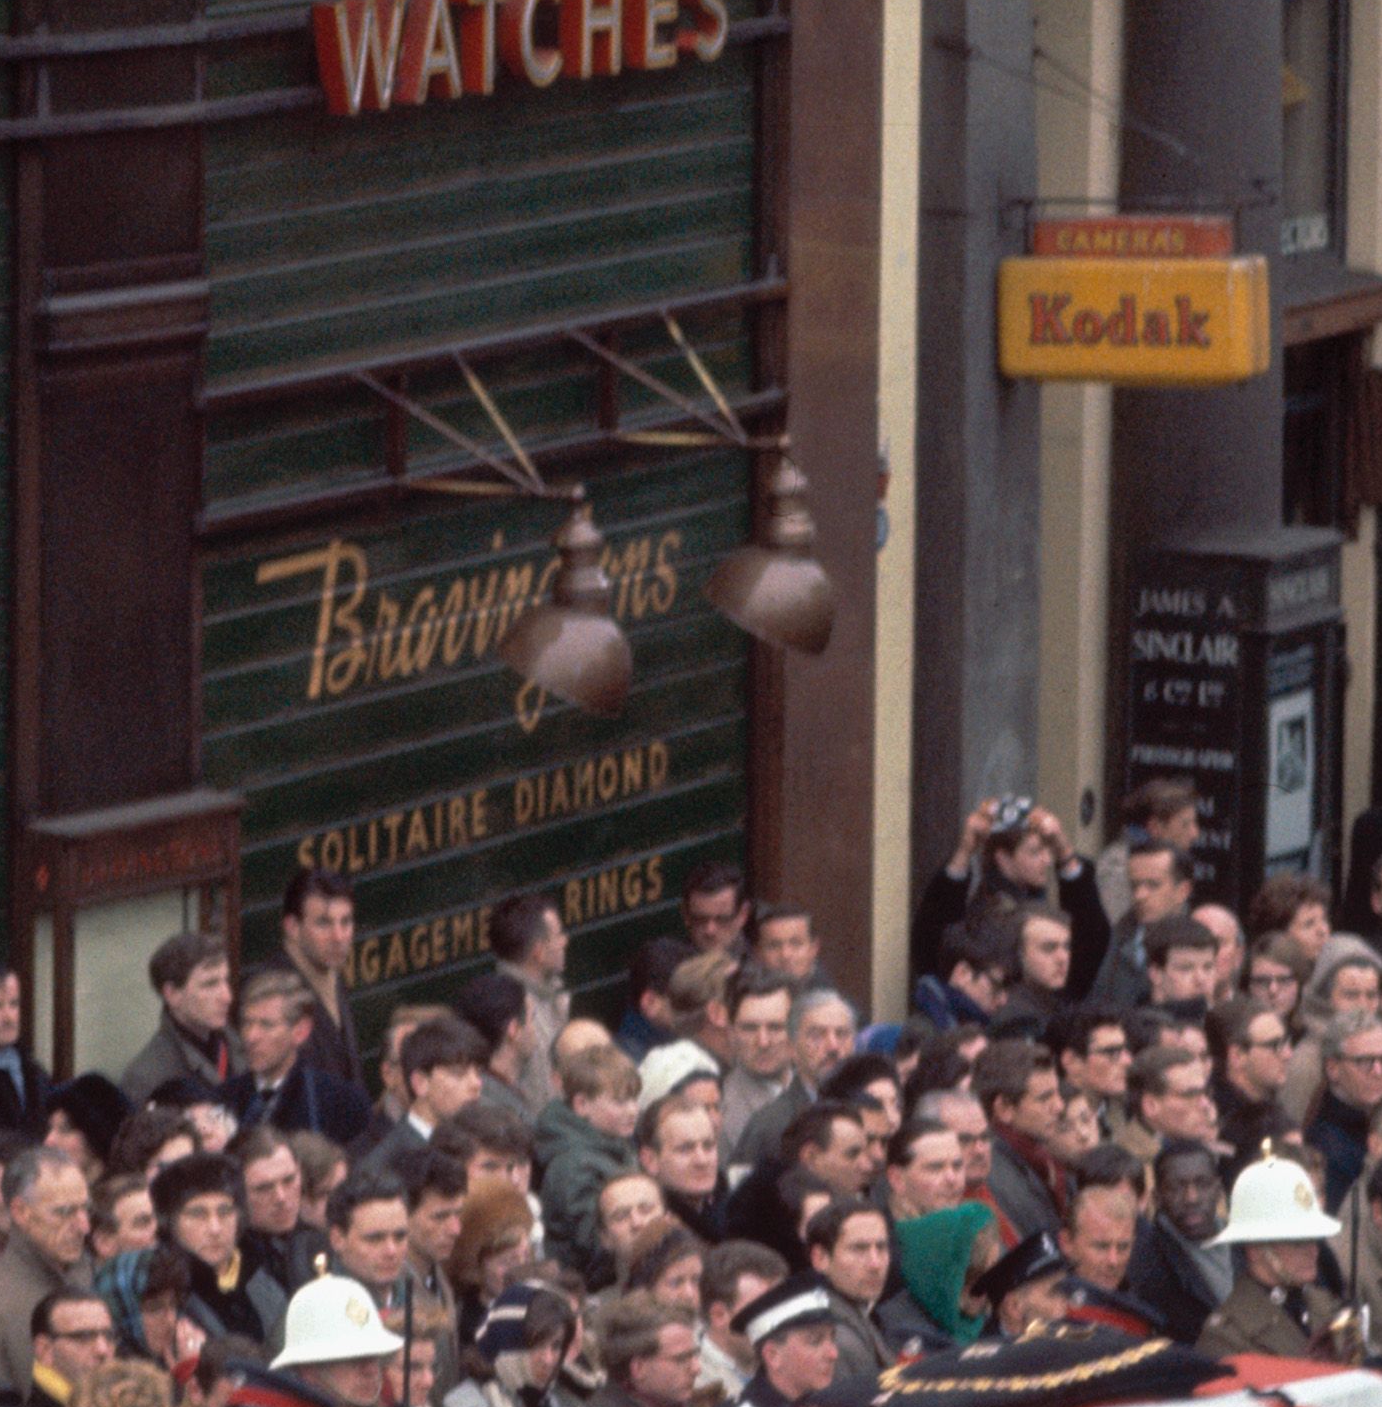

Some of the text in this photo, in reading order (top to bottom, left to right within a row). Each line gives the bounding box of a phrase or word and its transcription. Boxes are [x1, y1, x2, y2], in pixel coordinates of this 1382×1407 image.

[1055, 226, 1186, 254] CAMERAS
[1028, 293, 1211, 348] Kodak
[297, 739, 669, 875] SOLITAIRE DIAMOND
[563, 855, 665, 927] RINGS
